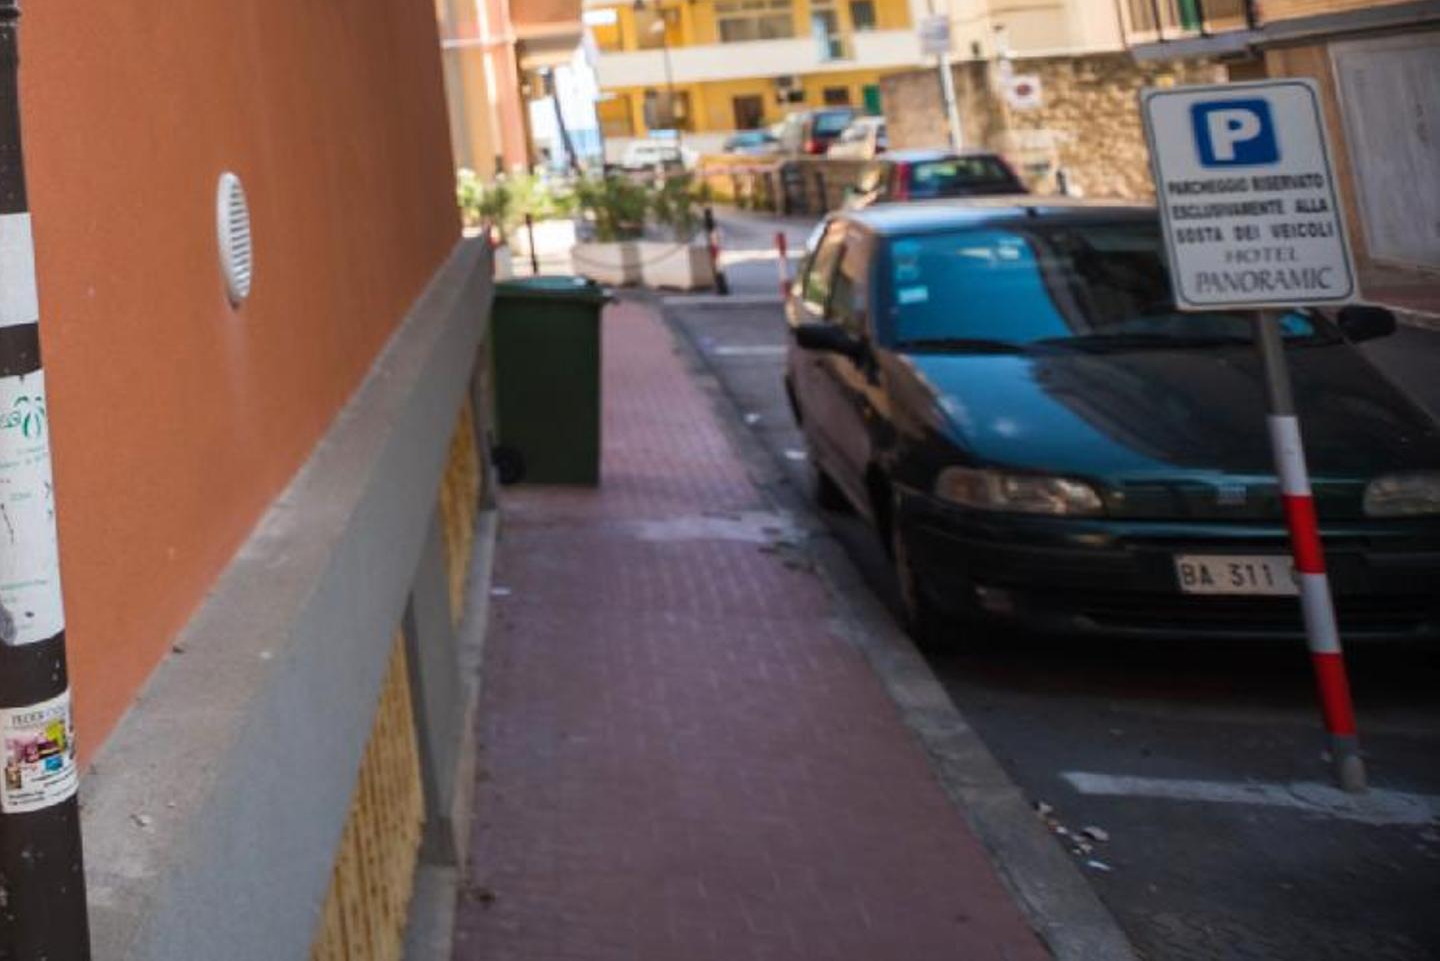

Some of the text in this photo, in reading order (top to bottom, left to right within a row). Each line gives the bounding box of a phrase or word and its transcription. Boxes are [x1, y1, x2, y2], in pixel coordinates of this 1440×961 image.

[1207, 107, 1262, 161] P
[1168, 173, 1324, 195] PARCHEGGIO RISERVATO
[1172, 198, 1328, 220] ESCLUSIVAMENTE ALLA
[1177, 222, 1333, 243] SOSTA DEI VEICOLI
[1225, 246, 1299, 265] HOTEL
[1195, 267, 1333, 293] PANORAMIC
[1180, 563, 1215, 586] BA
[1229, 562, 1275, 587] 311
